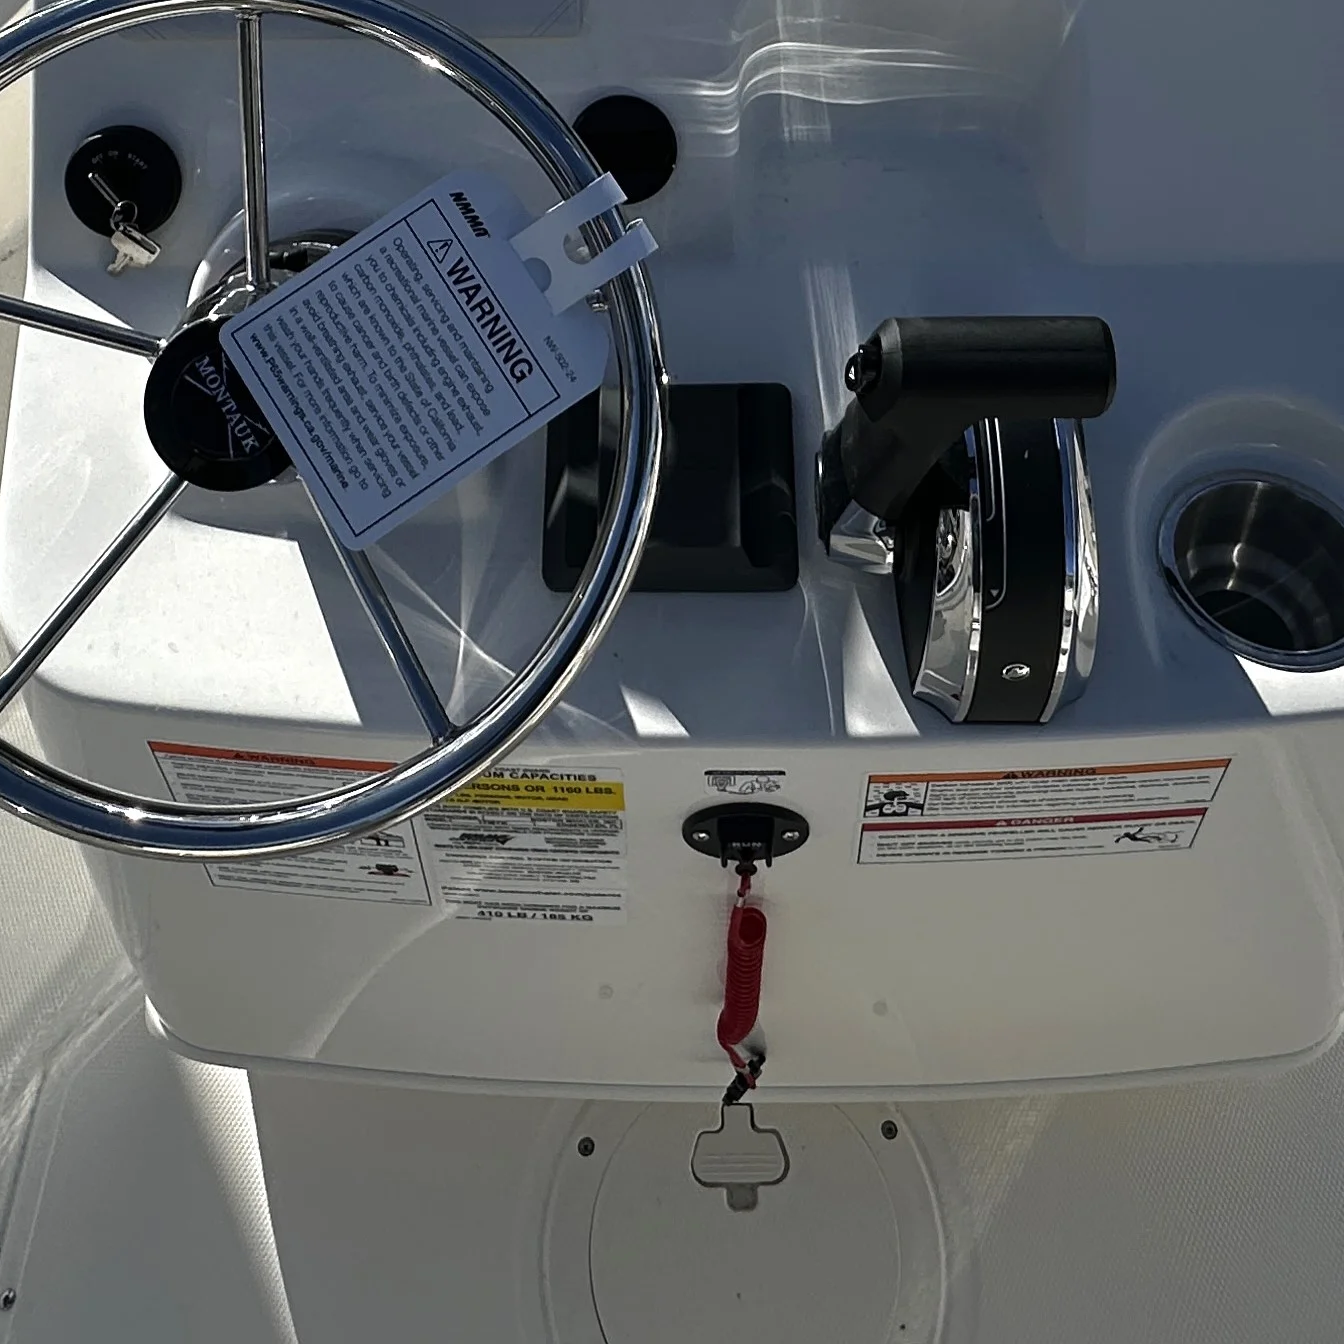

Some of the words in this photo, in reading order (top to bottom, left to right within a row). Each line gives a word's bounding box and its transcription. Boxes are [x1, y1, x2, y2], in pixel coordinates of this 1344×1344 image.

[314, 288, 353, 344] reproductive
[374, 382, 402, 424] minimize
[334, 291, 356, 320] cause
[351, 318, 376, 349] cancer
[370, 350, 388, 370] and
[382, 367, 400, 392] birth
[396, 390, 422, 426] defects
[425, 436, 445, 461] other
[341, 271, 361, 299] which
[357, 298, 371, 315] are
[367, 313, 390, 346] known
[393, 355, 407, 373] the
[403, 371, 423, 398] State
[426, 407, 456, 452] California
[353, 263, 377, 295] carbon
[433, 390, 451, 411] and
[364, 253, 381, 273] you
[384, 282, 416, 327] chemicals
[411, 325, 441, 368] including
[436, 365, 460, 397] engine
[383, 253, 422, 305] recreational
[415, 303, 439, 336] marine
[436, 334, 459, 365] vessel
[453, 363, 469, 382] can
[465, 381, 491, 416] expose
[421, 282, 450, 324] servicing
[446, 322, 464, 342] and
[458, 340, 494, 394] maintaining
[445, 255, 533, 384] WARNING
[194, 355, 260, 455] MONTAUK
[262, 322, 277, 342] this
[292, 371, 307, 388] For
[303, 388, 321, 415] more
[318, 413, 353, 465] information
[275, 314, 295, 340] wash
[289, 340, 308, 360] your
[303, 358, 325, 390] hands
[320, 387, 351, 432] frequently
[348, 431, 367, 458] when
[363, 457, 392, 499] servicing
[299, 323, 343, 385] well-ventilated
[336, 384, 354, 406] area
[349, 404, 367, 425] and
[361, 423, 380, 446] wear
[373, 446, 398, 478] gloves
[301, 298, 322, 323] avoid
[316, 320, 345, 364] breathing
[364, 398, 388, 431] service
[382, 429, 401, 450] your
[396, 449, 420, 479] vessel
[508, 772, 597, 782] CAPACITIES
[524, 785, 546, 793] OR
[551, 786, 582, 794] 1160
[585, 787, 617, 795] LBS.
[1009, 815, 1075, 827] DANGER
[1019, 767, 1098, 780] WARNING
[731, 841, 762, 849] RUN
[477, 910, 503, 918] 410
[570, 913, 594, 921] KG
